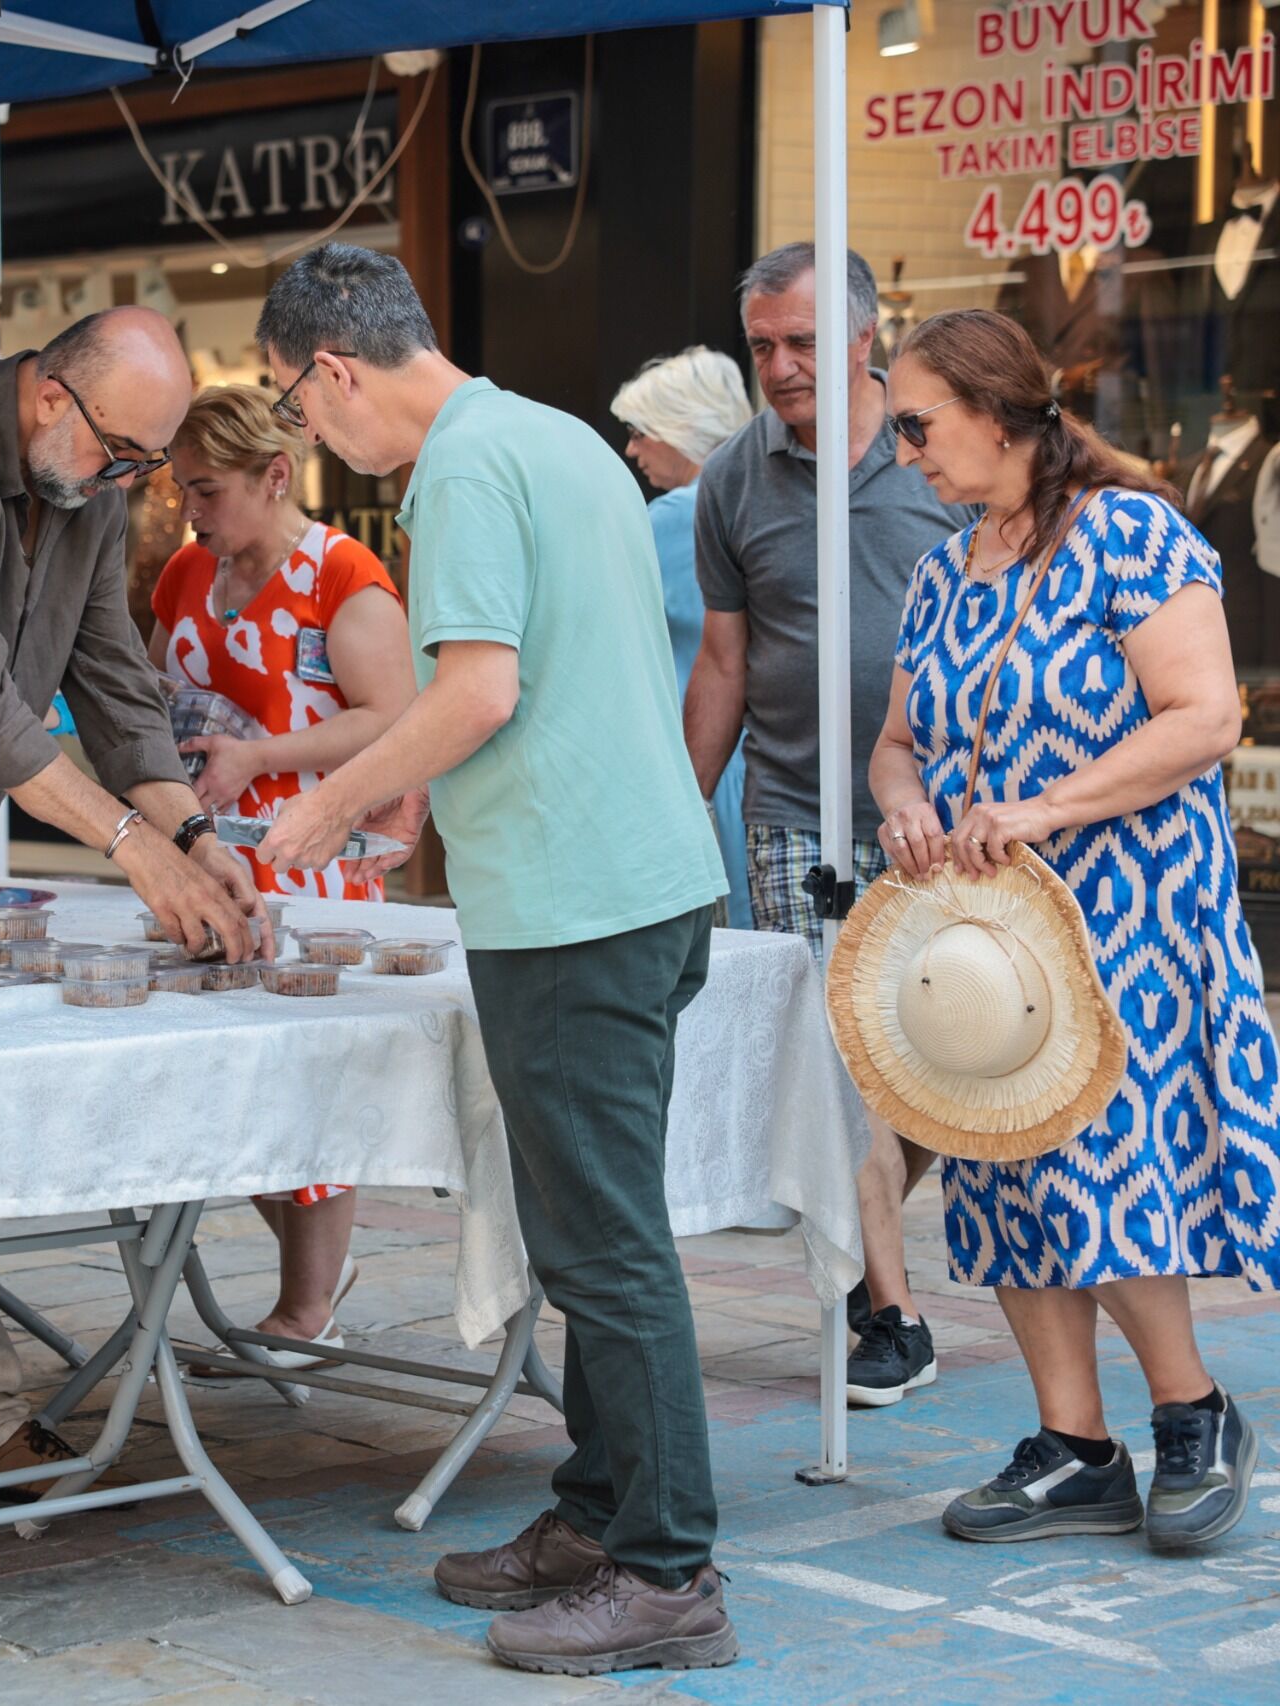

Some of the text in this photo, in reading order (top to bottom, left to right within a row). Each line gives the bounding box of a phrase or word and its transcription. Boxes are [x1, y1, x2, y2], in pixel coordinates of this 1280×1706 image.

[865, 34, 1273, 138] SEZON İNDİRİMİ
[160, 129, 395, 224] KATRE
[939, 112, 1200, 175] TAKIM ELBİSE
